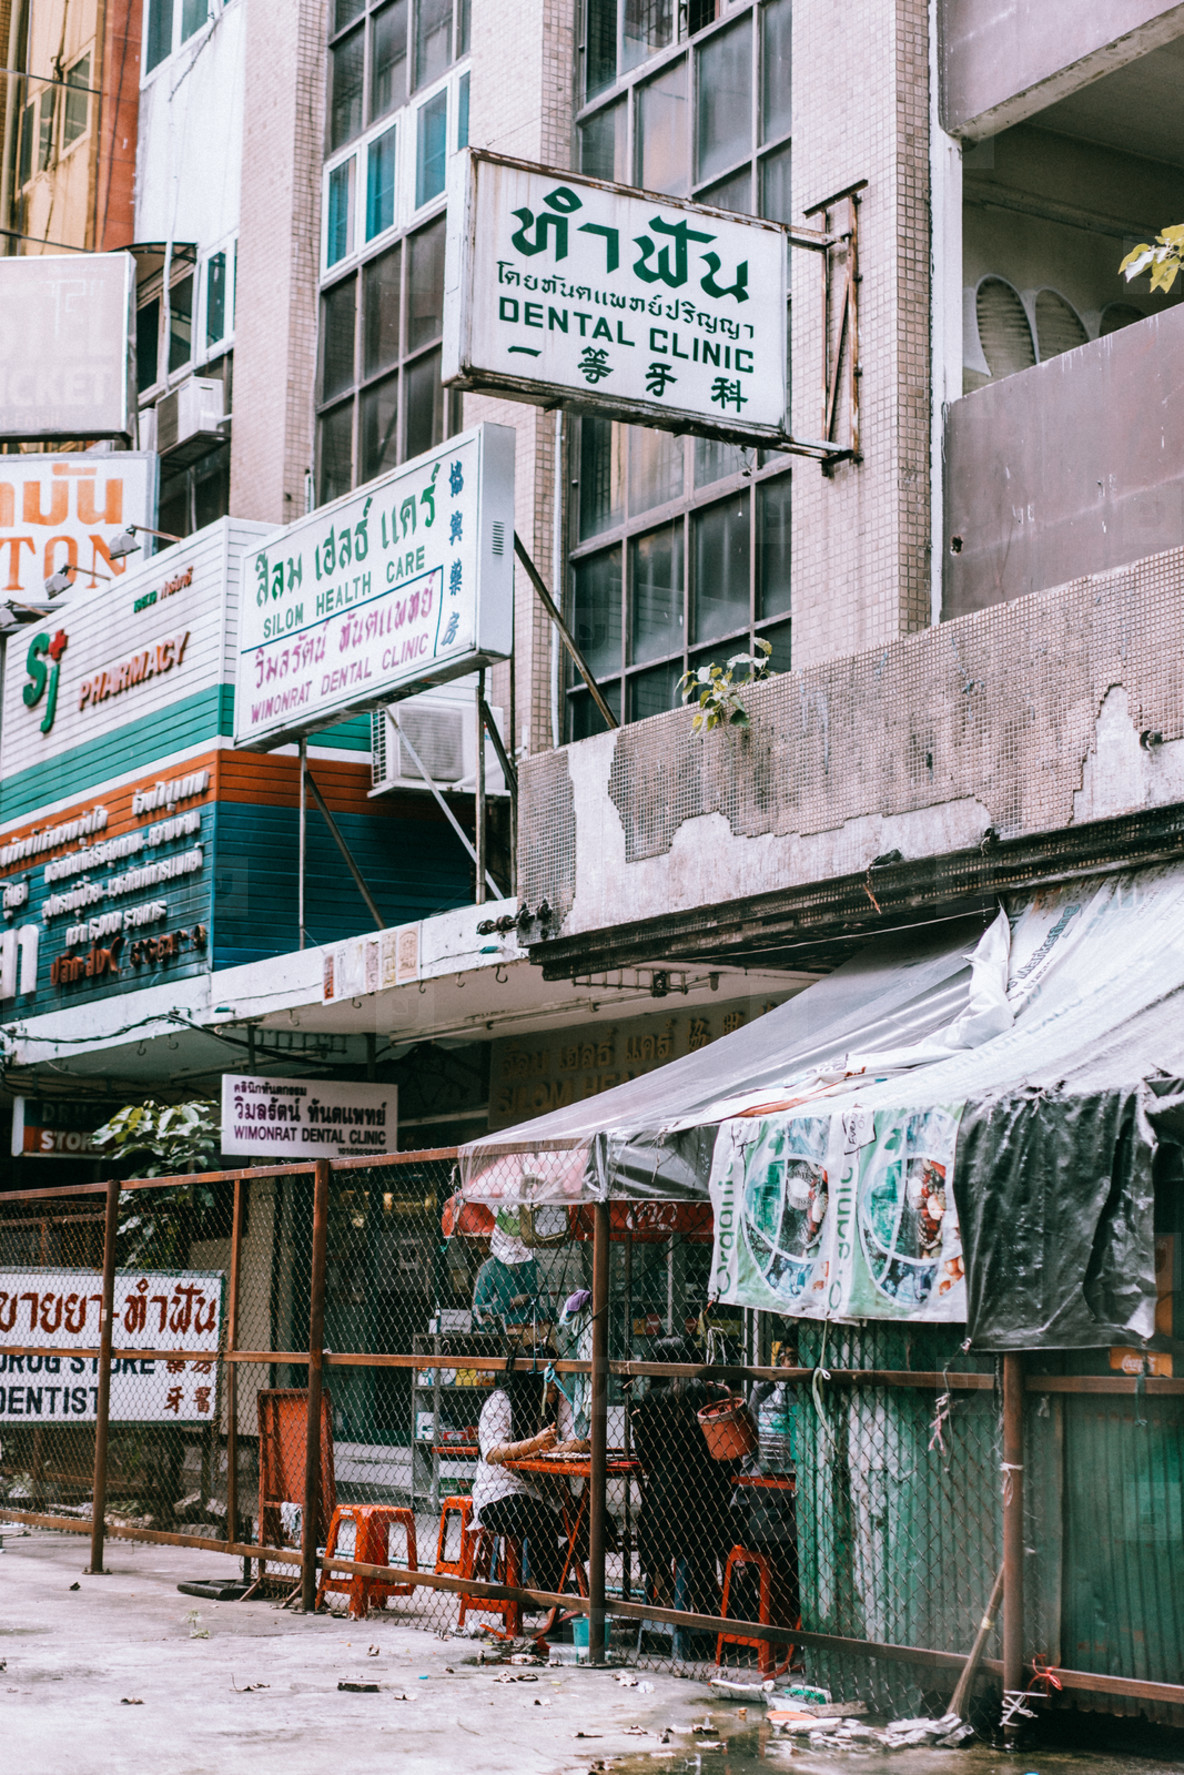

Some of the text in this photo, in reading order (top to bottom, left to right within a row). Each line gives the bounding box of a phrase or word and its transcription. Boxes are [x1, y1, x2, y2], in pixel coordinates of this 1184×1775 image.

[511, 187, 749, 303] ทำฟัน
[497, 261, 754, 340] โดยทันตแพทย์ปริญญา
[499, 296, 754, 374] DENTAL CLINIC
[382, 462, 441, 550] แคร์
[263, 546, 425, 639] SILOM HEALTH CARE
[79, 631, 190, 711] PHARMACY
[251, 633, 429, 724] WIMONRAT DENTAL CLINIC
[234, 1125, 386, 1145] WIMONRAT DENTAL CLINIC
[829, 1166, 853, 1310] Oganic
